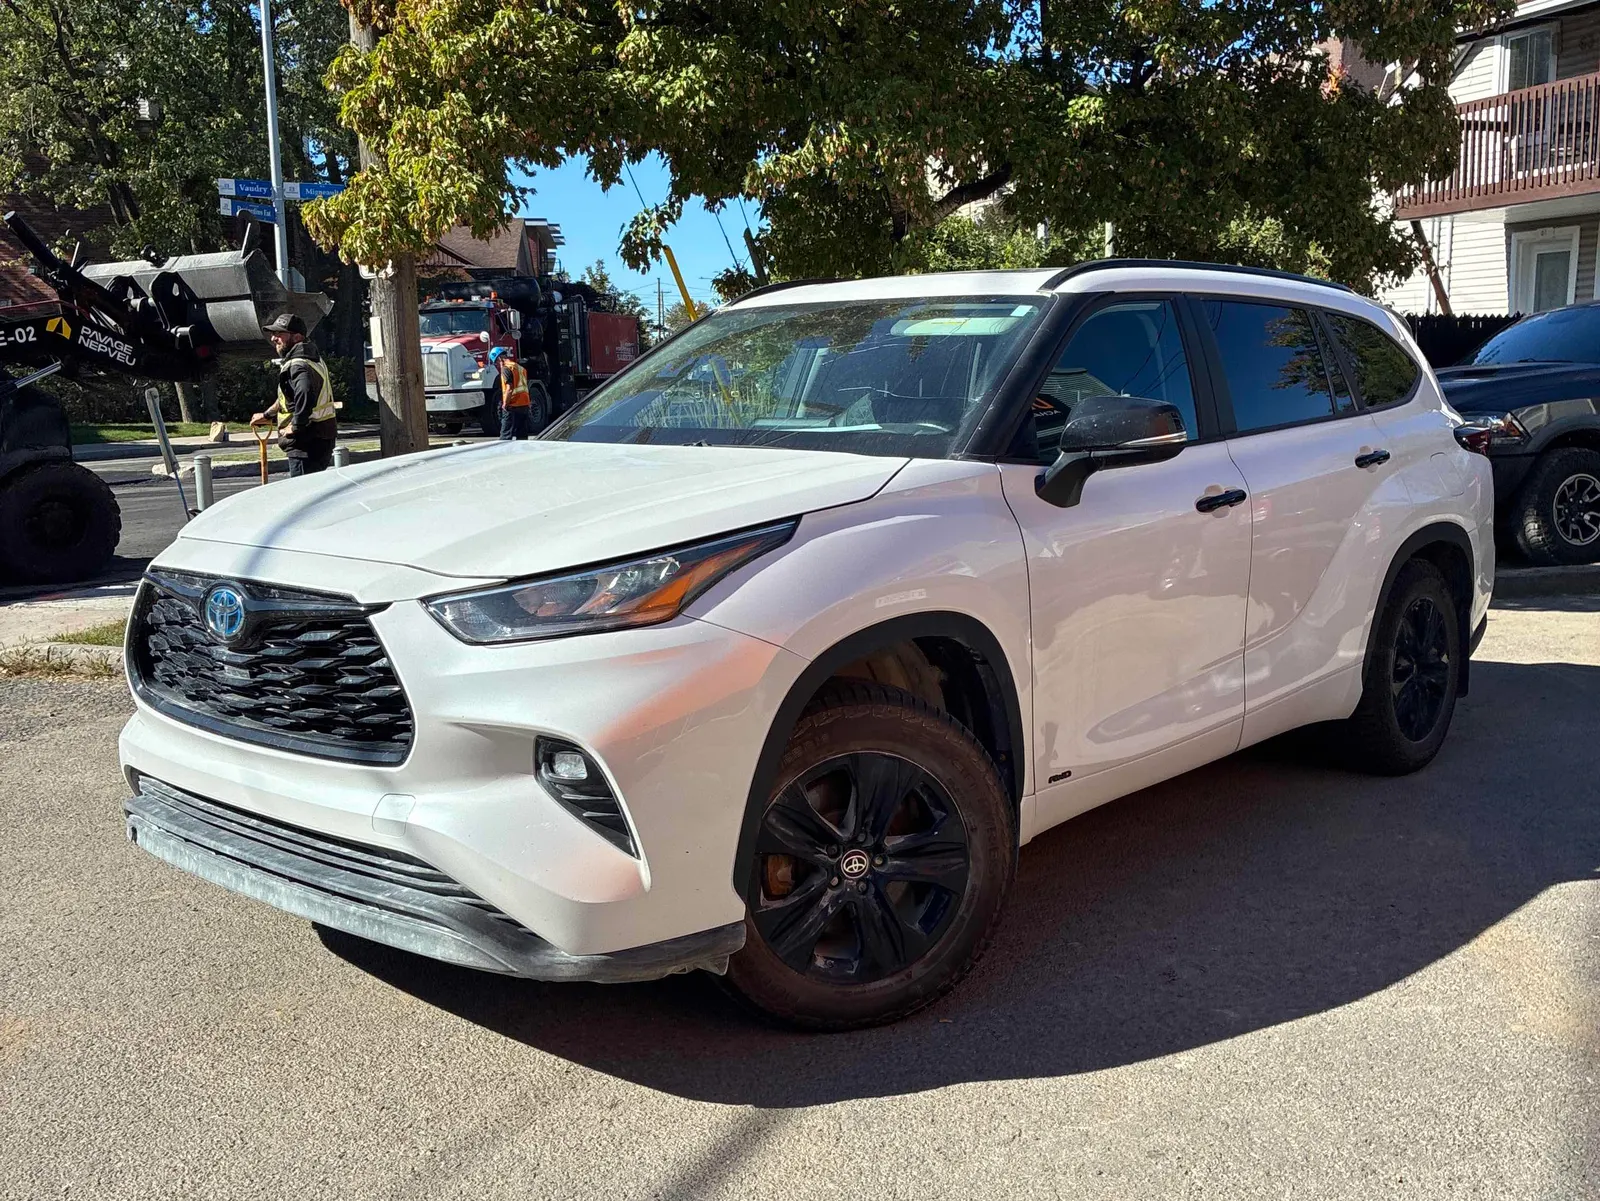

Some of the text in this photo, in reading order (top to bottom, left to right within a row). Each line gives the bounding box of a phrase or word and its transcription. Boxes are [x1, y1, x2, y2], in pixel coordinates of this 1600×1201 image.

[239, 183, 268, 195] Vaudry
[78, 335, 136, 367] NEPVEU
[80, 325, 133, 356] PAVAGE
